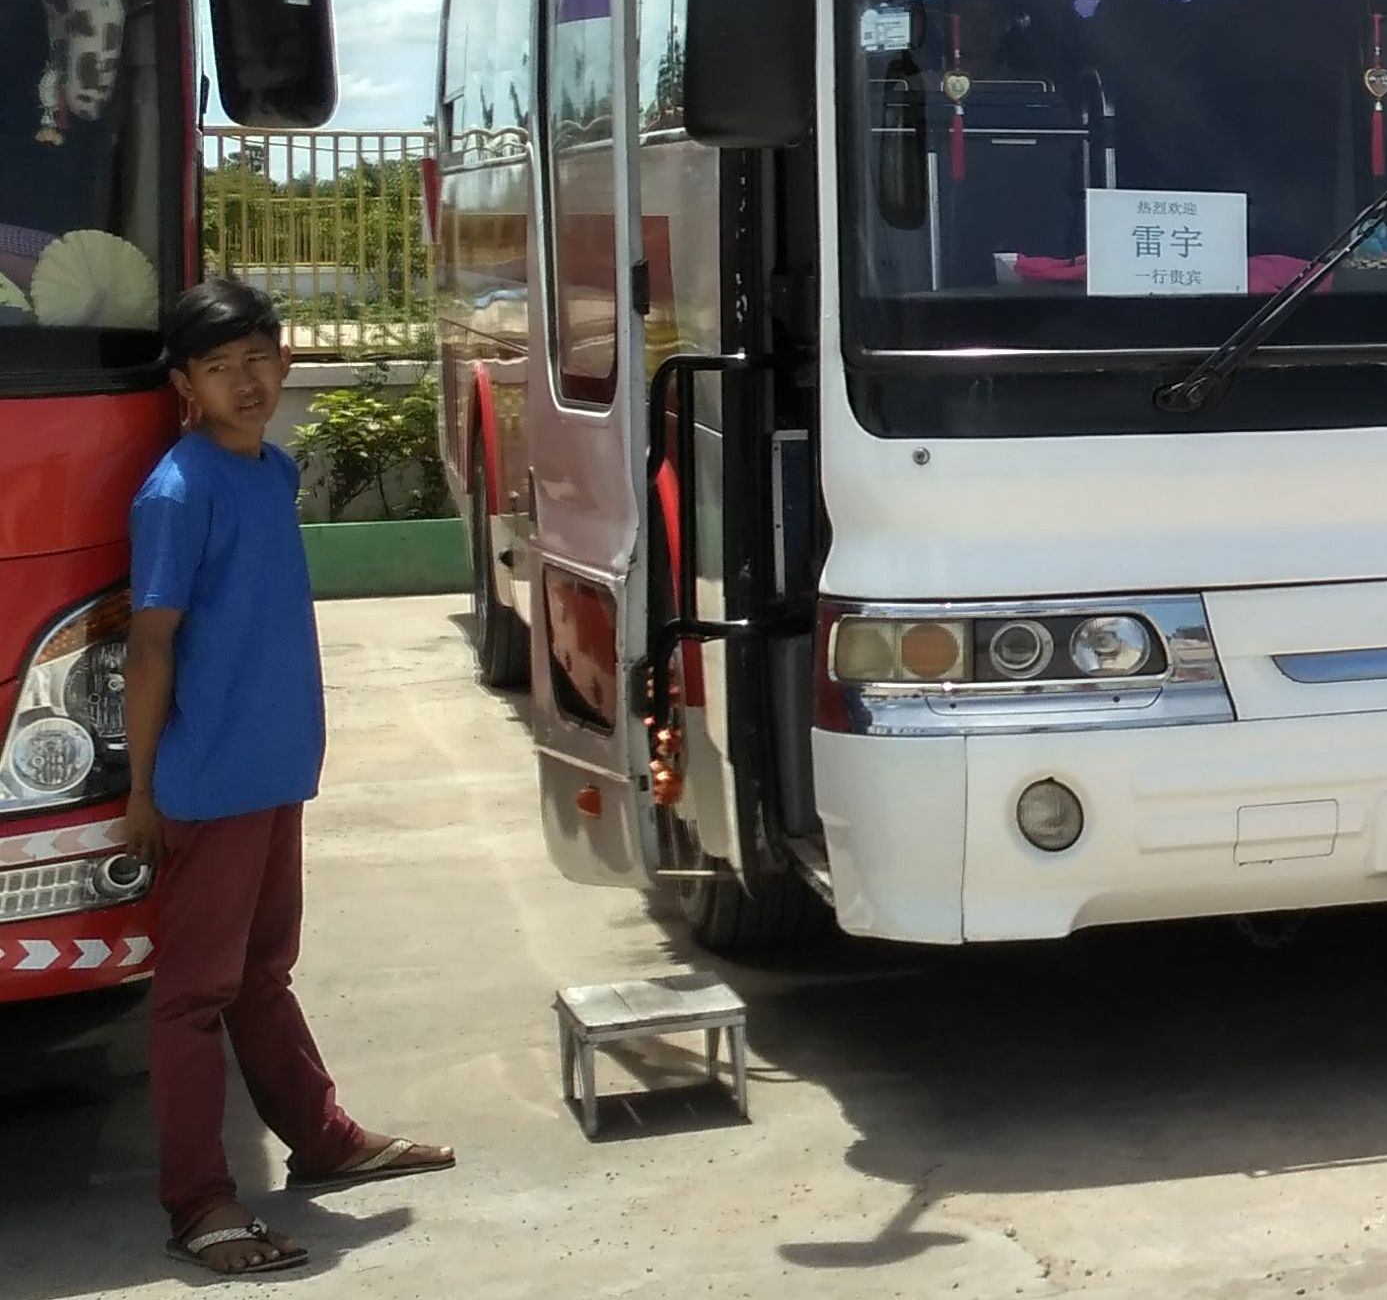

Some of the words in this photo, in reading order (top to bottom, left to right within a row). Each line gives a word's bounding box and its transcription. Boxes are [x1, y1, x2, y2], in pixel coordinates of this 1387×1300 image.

[1136, 201, 1198, 216] 热烈欢迎
[1131, 225, 1204, 258] 雷宇
[1135, 269, 1203, 286] 一行贵宾
